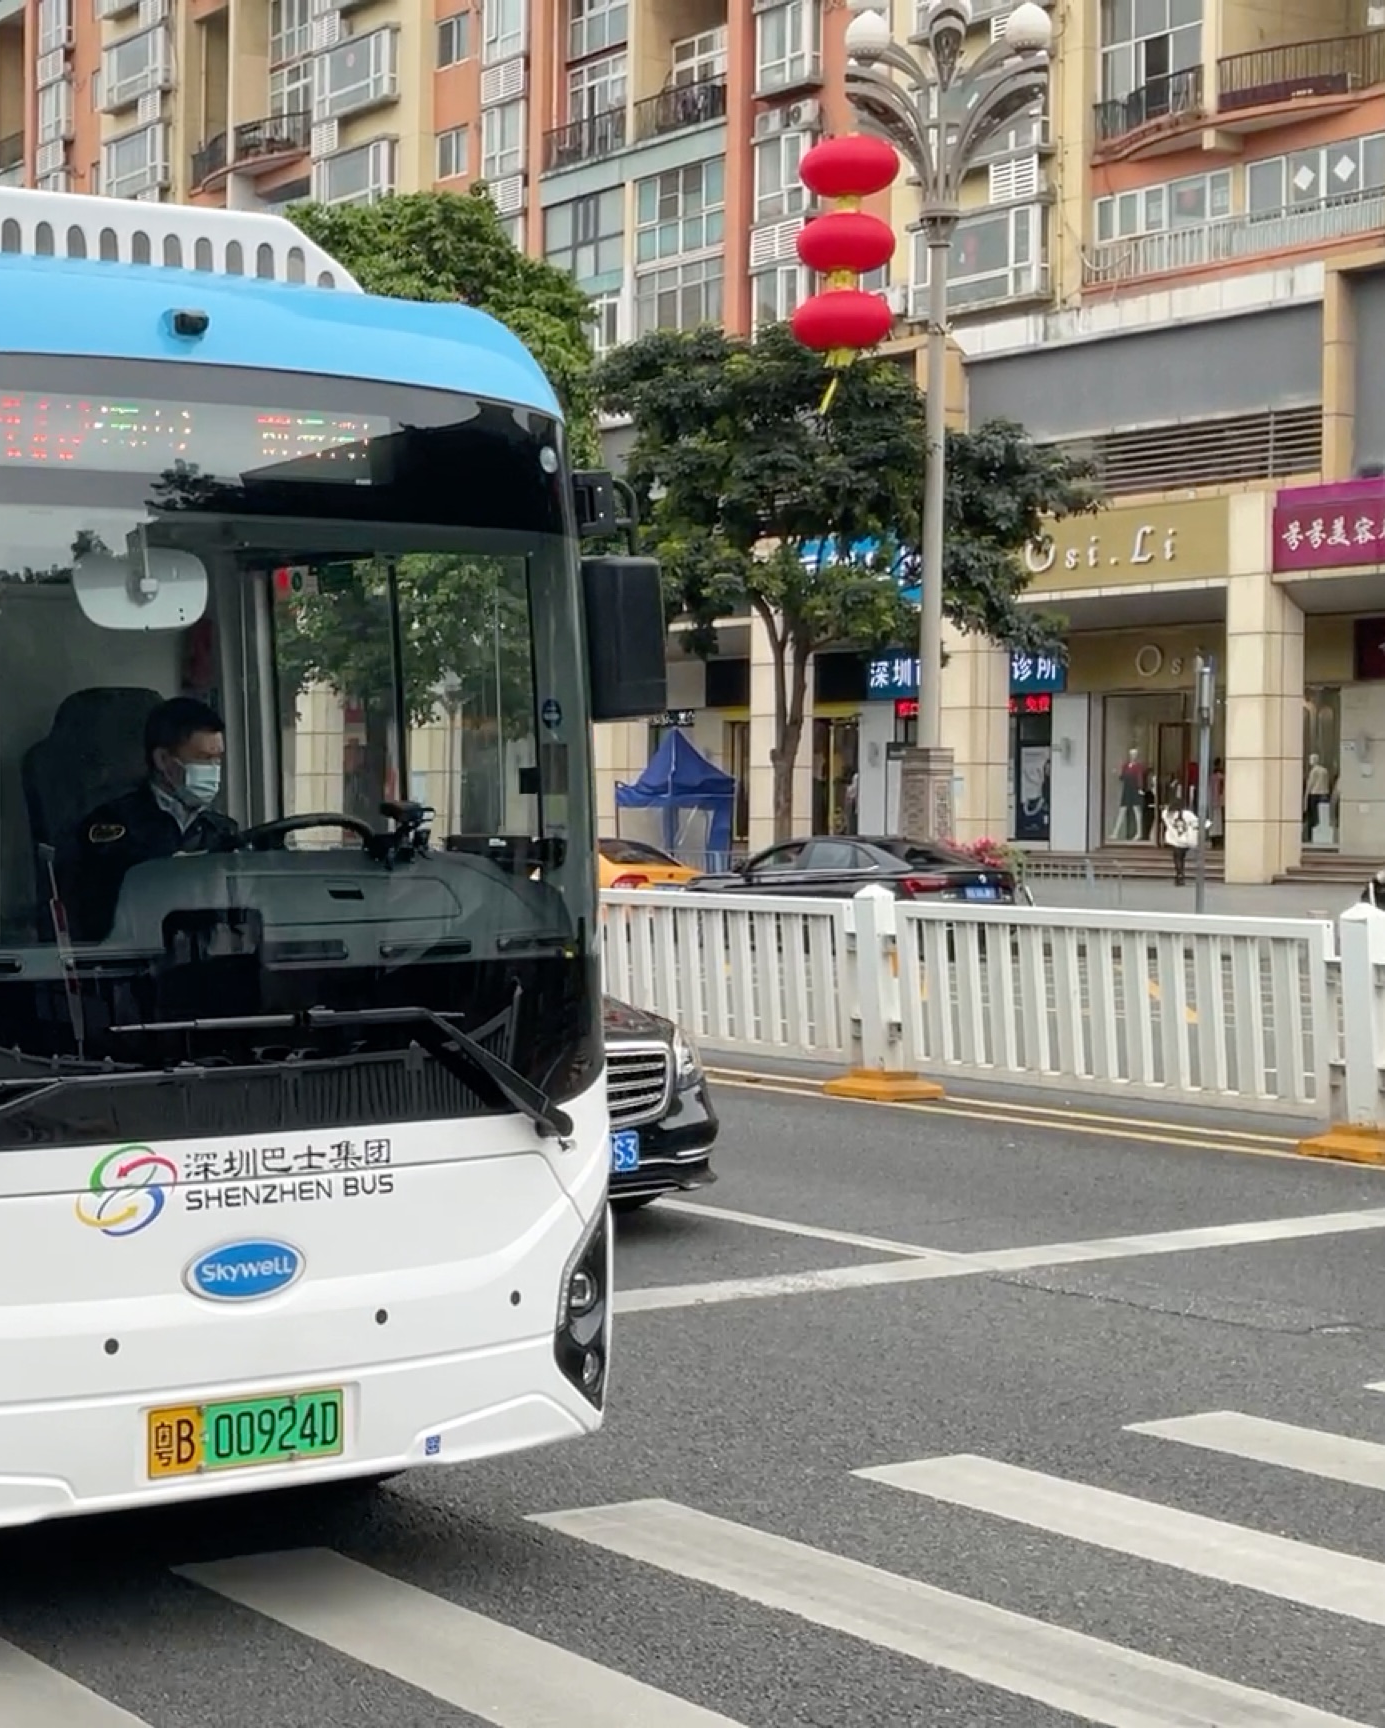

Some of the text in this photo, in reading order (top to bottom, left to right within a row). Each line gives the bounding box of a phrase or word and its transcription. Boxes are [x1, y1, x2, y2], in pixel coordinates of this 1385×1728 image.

[1012, 654, 1056, 682] 诊所
[183, 1139, 391, 1180] 深圳巴士集团
[185, 1174, 394, 1211] SHENZHEN BUS
[154, 1401, 339, 1467] 粤B 00924D
